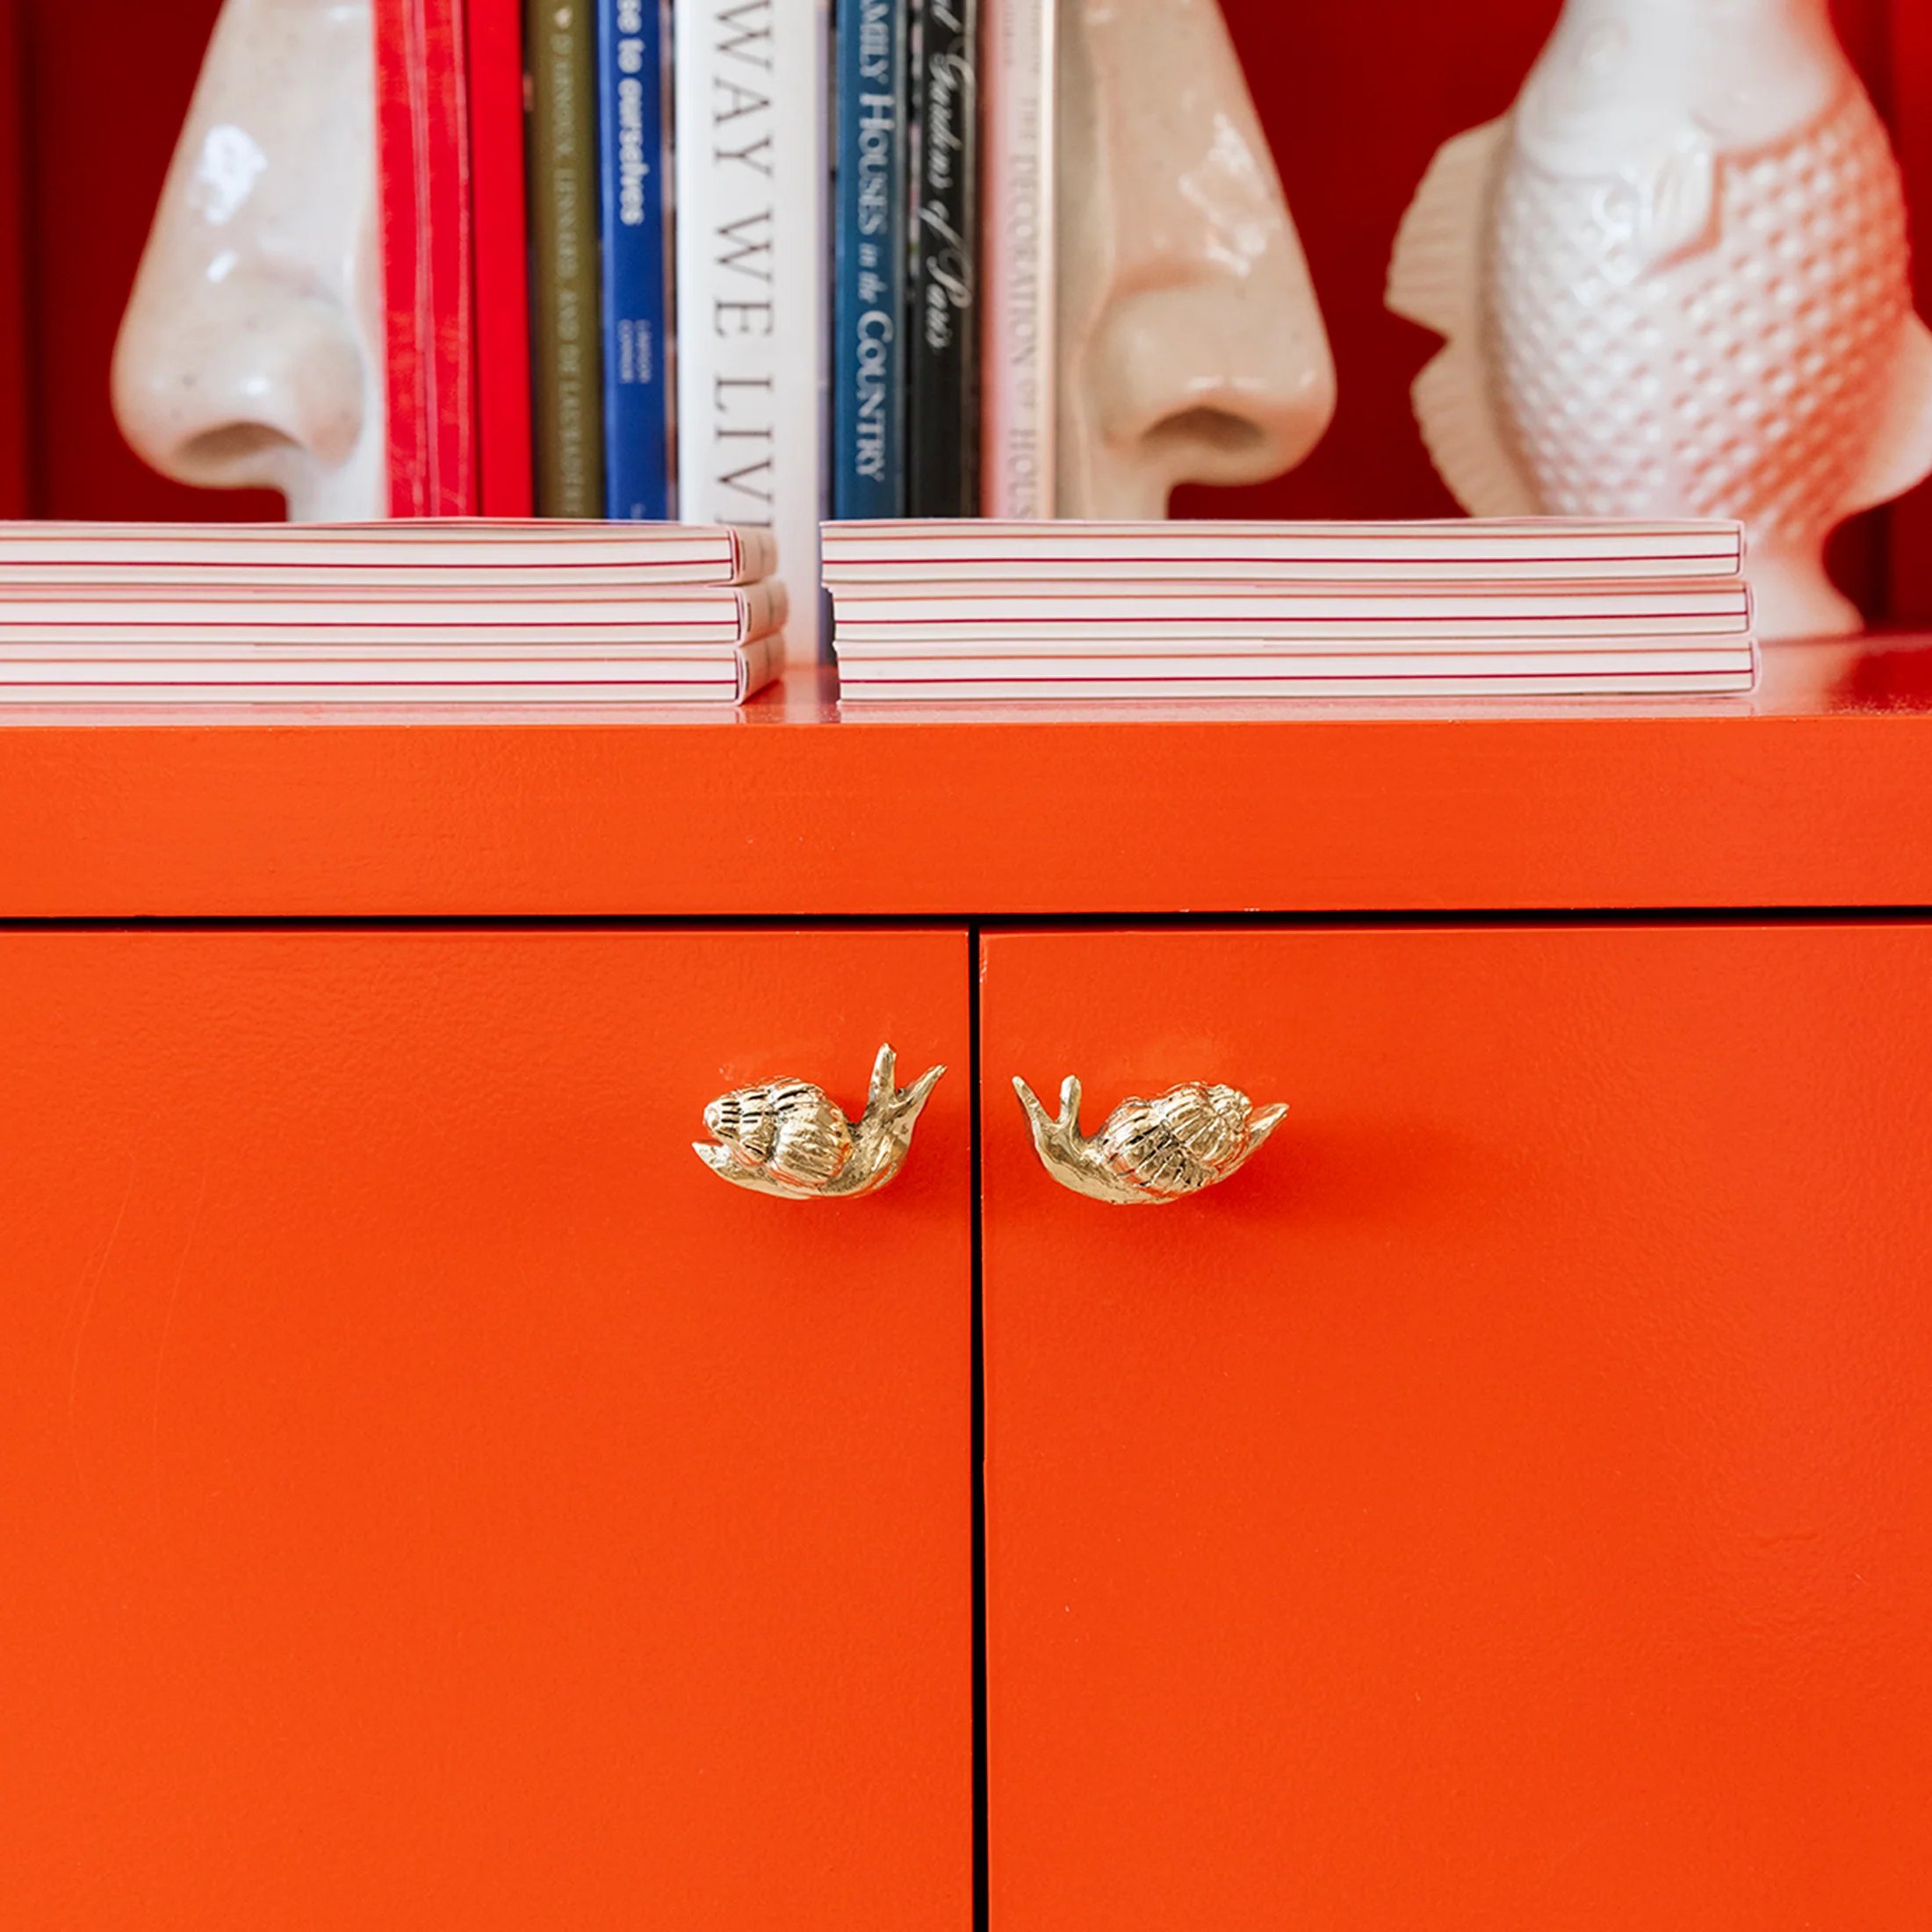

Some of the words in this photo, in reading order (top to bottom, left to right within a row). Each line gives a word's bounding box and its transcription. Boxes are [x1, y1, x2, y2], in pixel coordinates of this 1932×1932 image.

[617, 38, 644, 73] to
[713, 0, 774, 177] WAY
[928, 35, 976, 189] Gardens
[617, 77, 648, 226] ourselves
[858, 91, 894, 235] HOUSES
[713, 210, 774, 339] WE
[858, 270, 887, 301] the
[859, 242, 878, 266] in
[916, 199, 966, 253] of
[926, 244, 972, 349] Paris
[856, 310, 893, 481] COUNTRY
